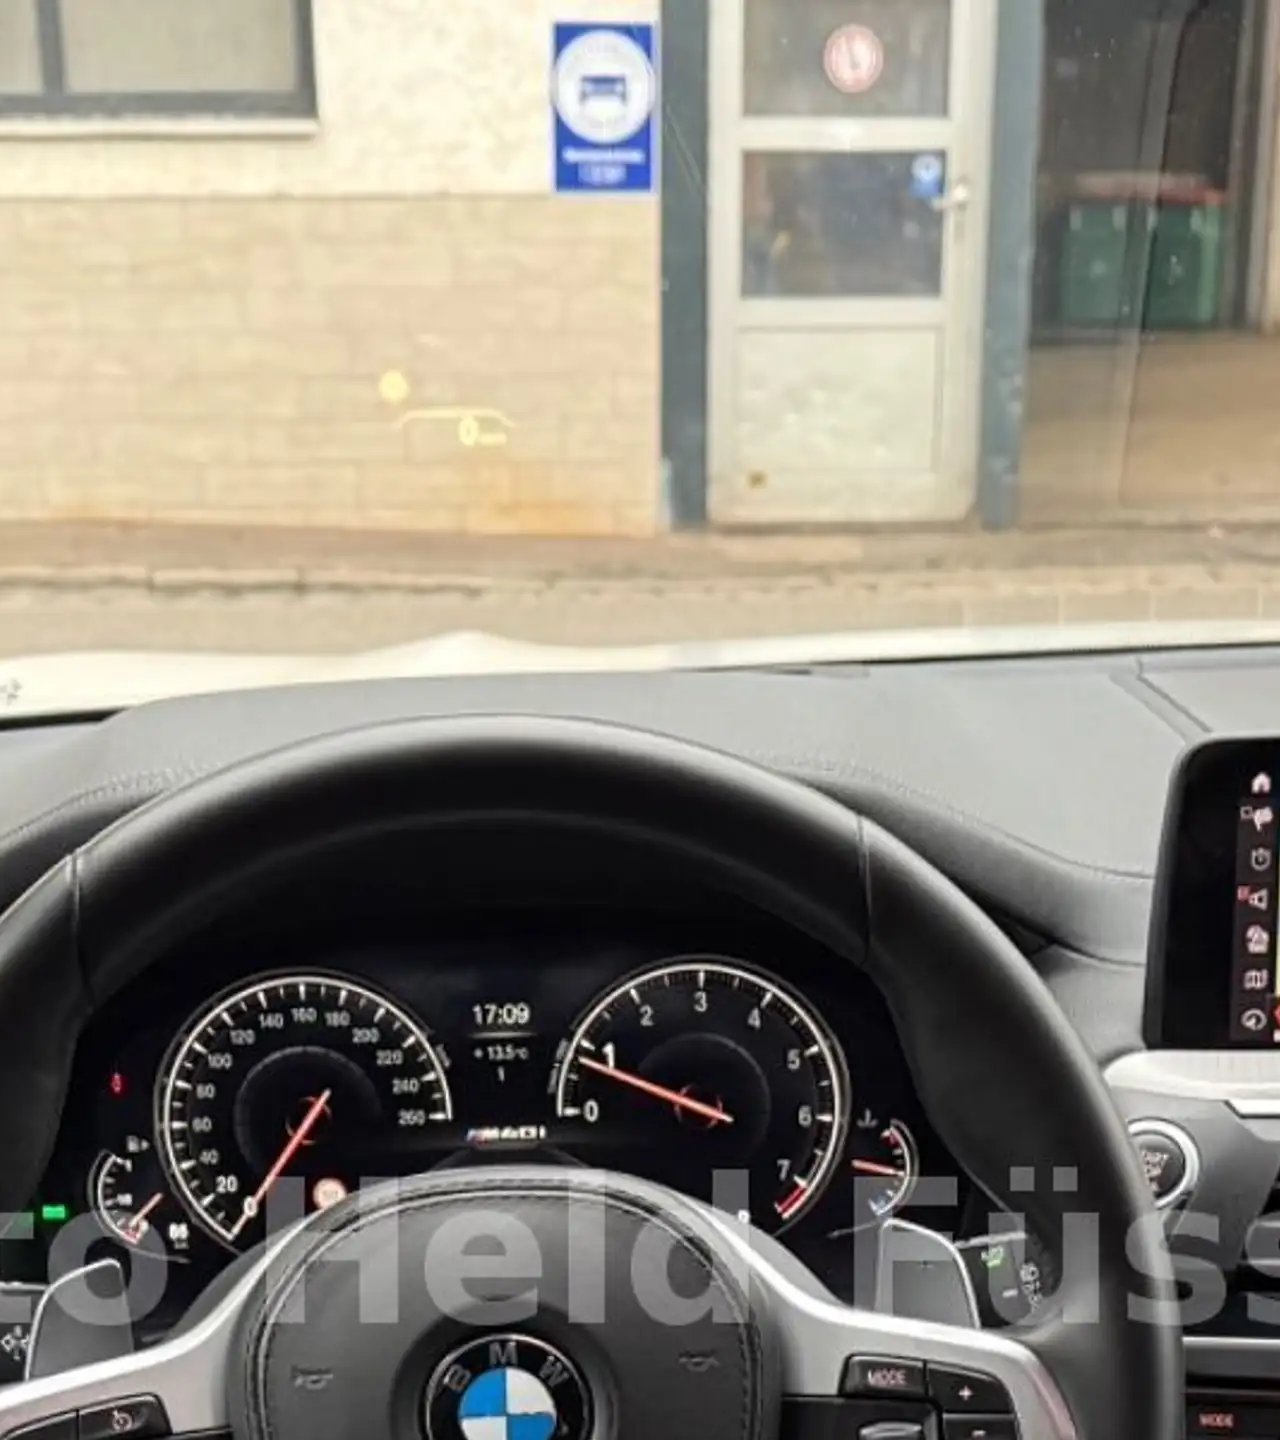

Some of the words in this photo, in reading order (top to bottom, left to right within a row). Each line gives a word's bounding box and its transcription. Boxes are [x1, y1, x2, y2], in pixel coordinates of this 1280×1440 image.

[694, 991, 709, 1012] 3
[258, 1012, 284, 1028] 140
[291, 1006, 317, 1022] 160
[325, 1010, 351, 1027] 180
[472, 1000, 531, 1025] 17:09
[639, 1005, 655, 1027] 2
[747, 1008, 762, 1029] 4
[229, 1028, 256, 1045] 120
[352, 1028, 380, 1044] 200
[207, 1053, 233, 1069] 100
[376, 1049, 404, 1065] 220
[602, 1042, 616, 1068] 1
[787, 1048, 802, 1069] 5
[196, 1084, 216, 1099] 80
[392, 1078, 419, 1095] 240
[398, 1109, 426, 1125] 260
[583, 1099, 599, 1122] 0
[798, 1105, 812, 1125] 6
[192, 1116, 213, 1132] 60
[199, 1148, 219, 1165] 40
[776, 1158, 792, 1181] 7
[216, 1175, 239, 1194] 20
[243, 1197, 258, 1217] 0
[440, 1340, 570, 1392] BMW
[868, 1369, 907, 1386] MODE
